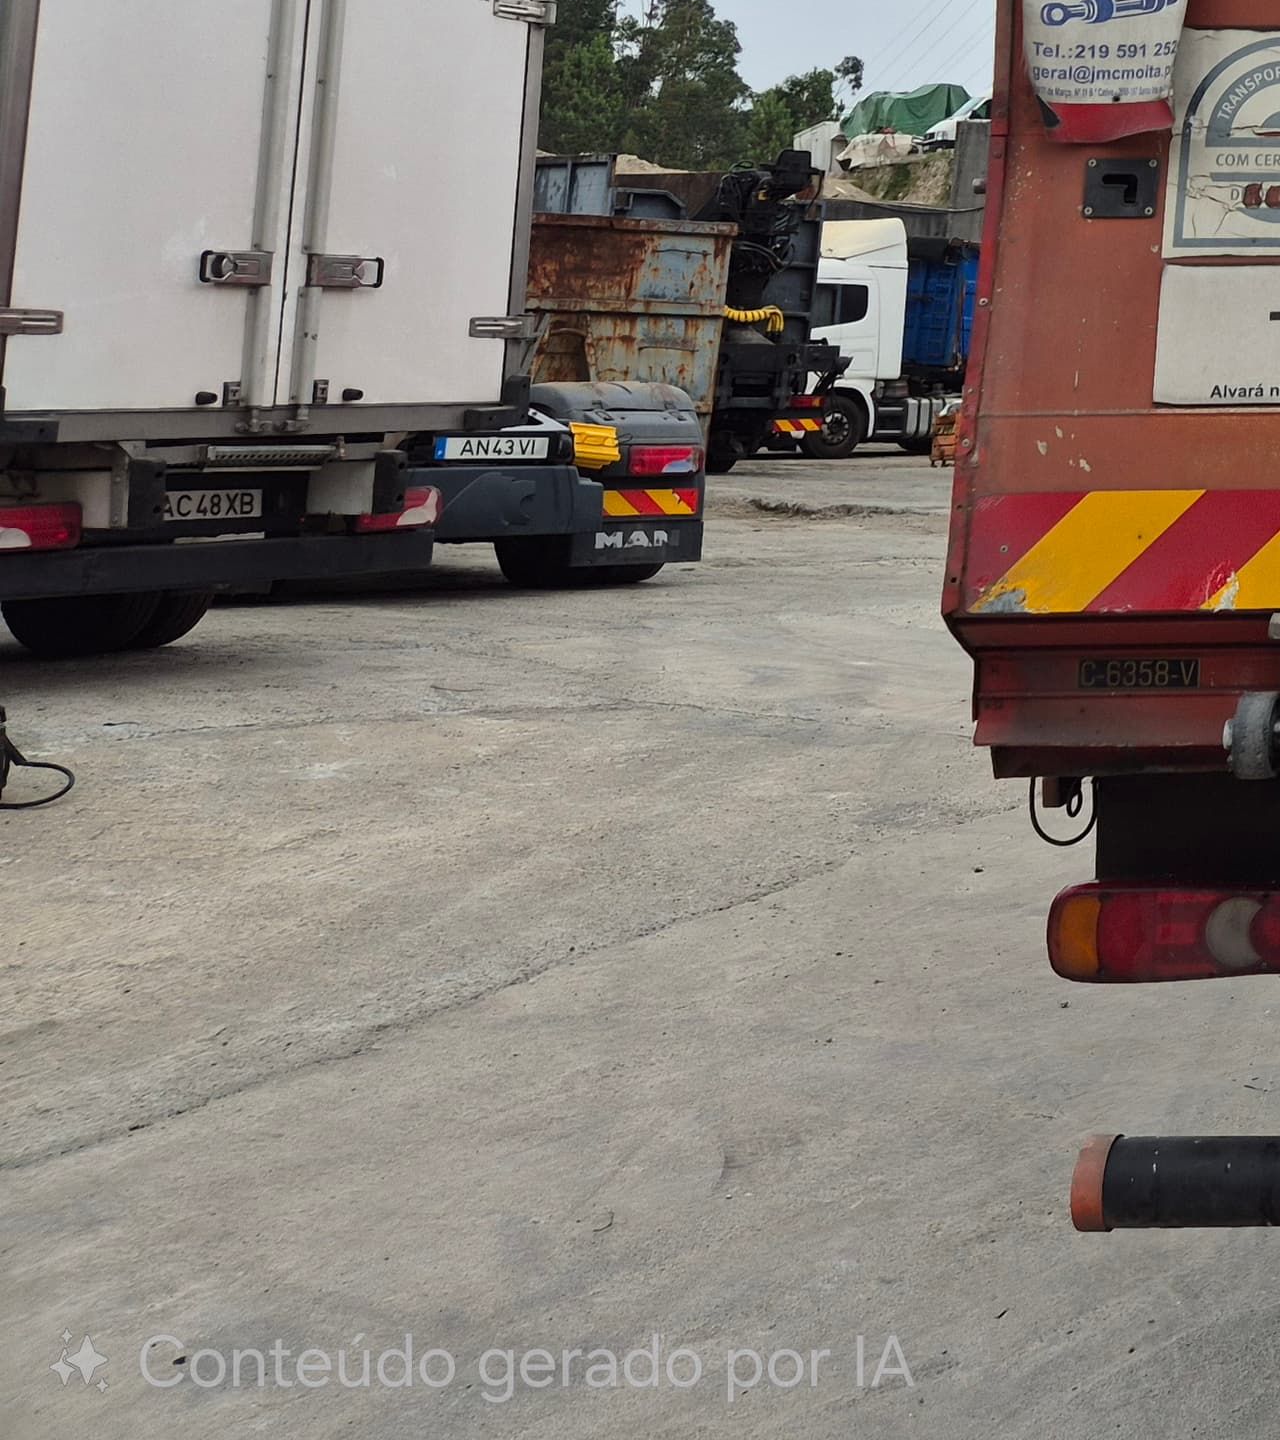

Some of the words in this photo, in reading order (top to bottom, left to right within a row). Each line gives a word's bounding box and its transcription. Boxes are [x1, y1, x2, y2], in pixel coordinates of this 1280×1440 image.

[1032, 41, 1110, 59] Tel.:219
[1117, 43, 1147, 59] 591
[1153, 40, 1177, 57] 252
[1216, 153, 1249, 167] COM
[1210, 383, 1264, 399] Alvará
[1081, 660, 1196, 686] C-6358-V
